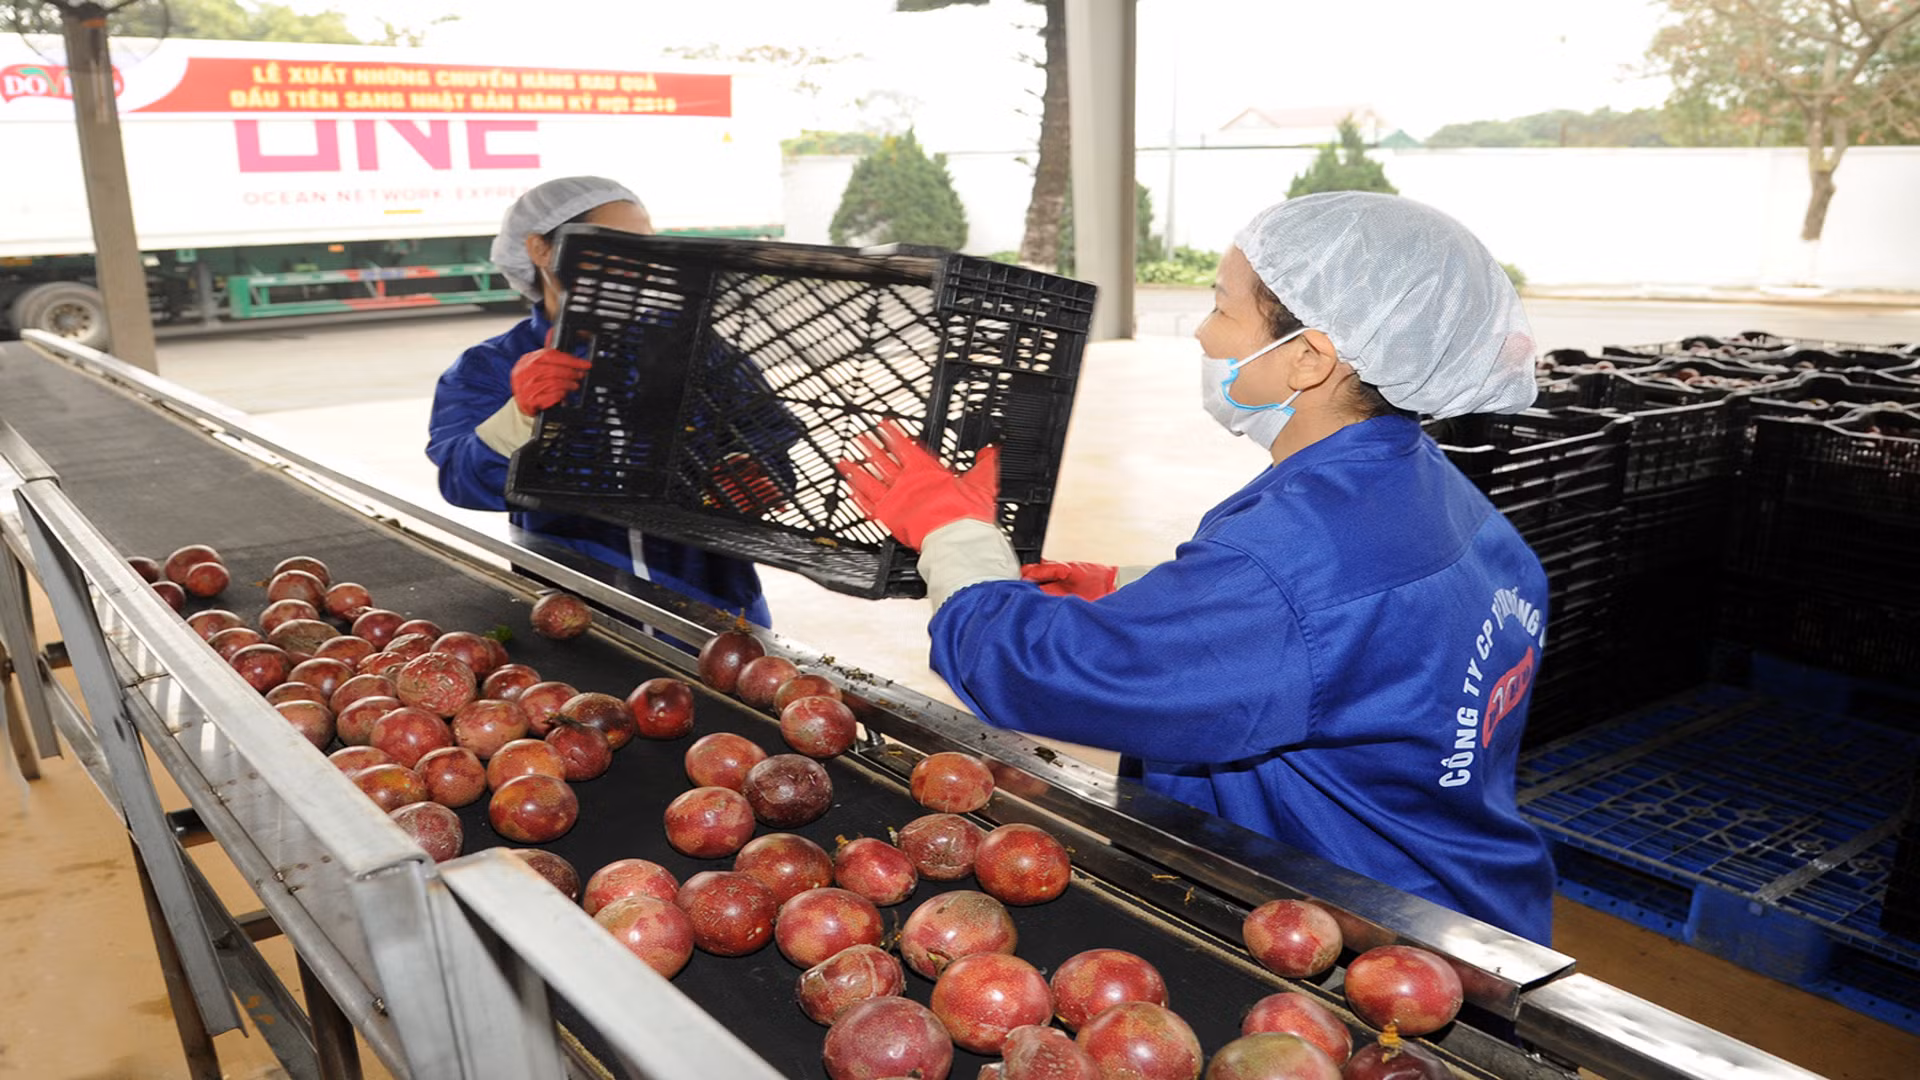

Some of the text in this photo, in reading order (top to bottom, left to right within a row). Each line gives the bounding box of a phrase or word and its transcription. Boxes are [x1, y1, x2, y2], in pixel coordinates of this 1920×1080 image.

[243, 185, 528, 205] OCEAN NETWORK EXPRE
[1439, 707, 1479, 787] CÔNG
[1463, 657, 1484, 697] TY
[1476, 618, 1494, 660] CP
